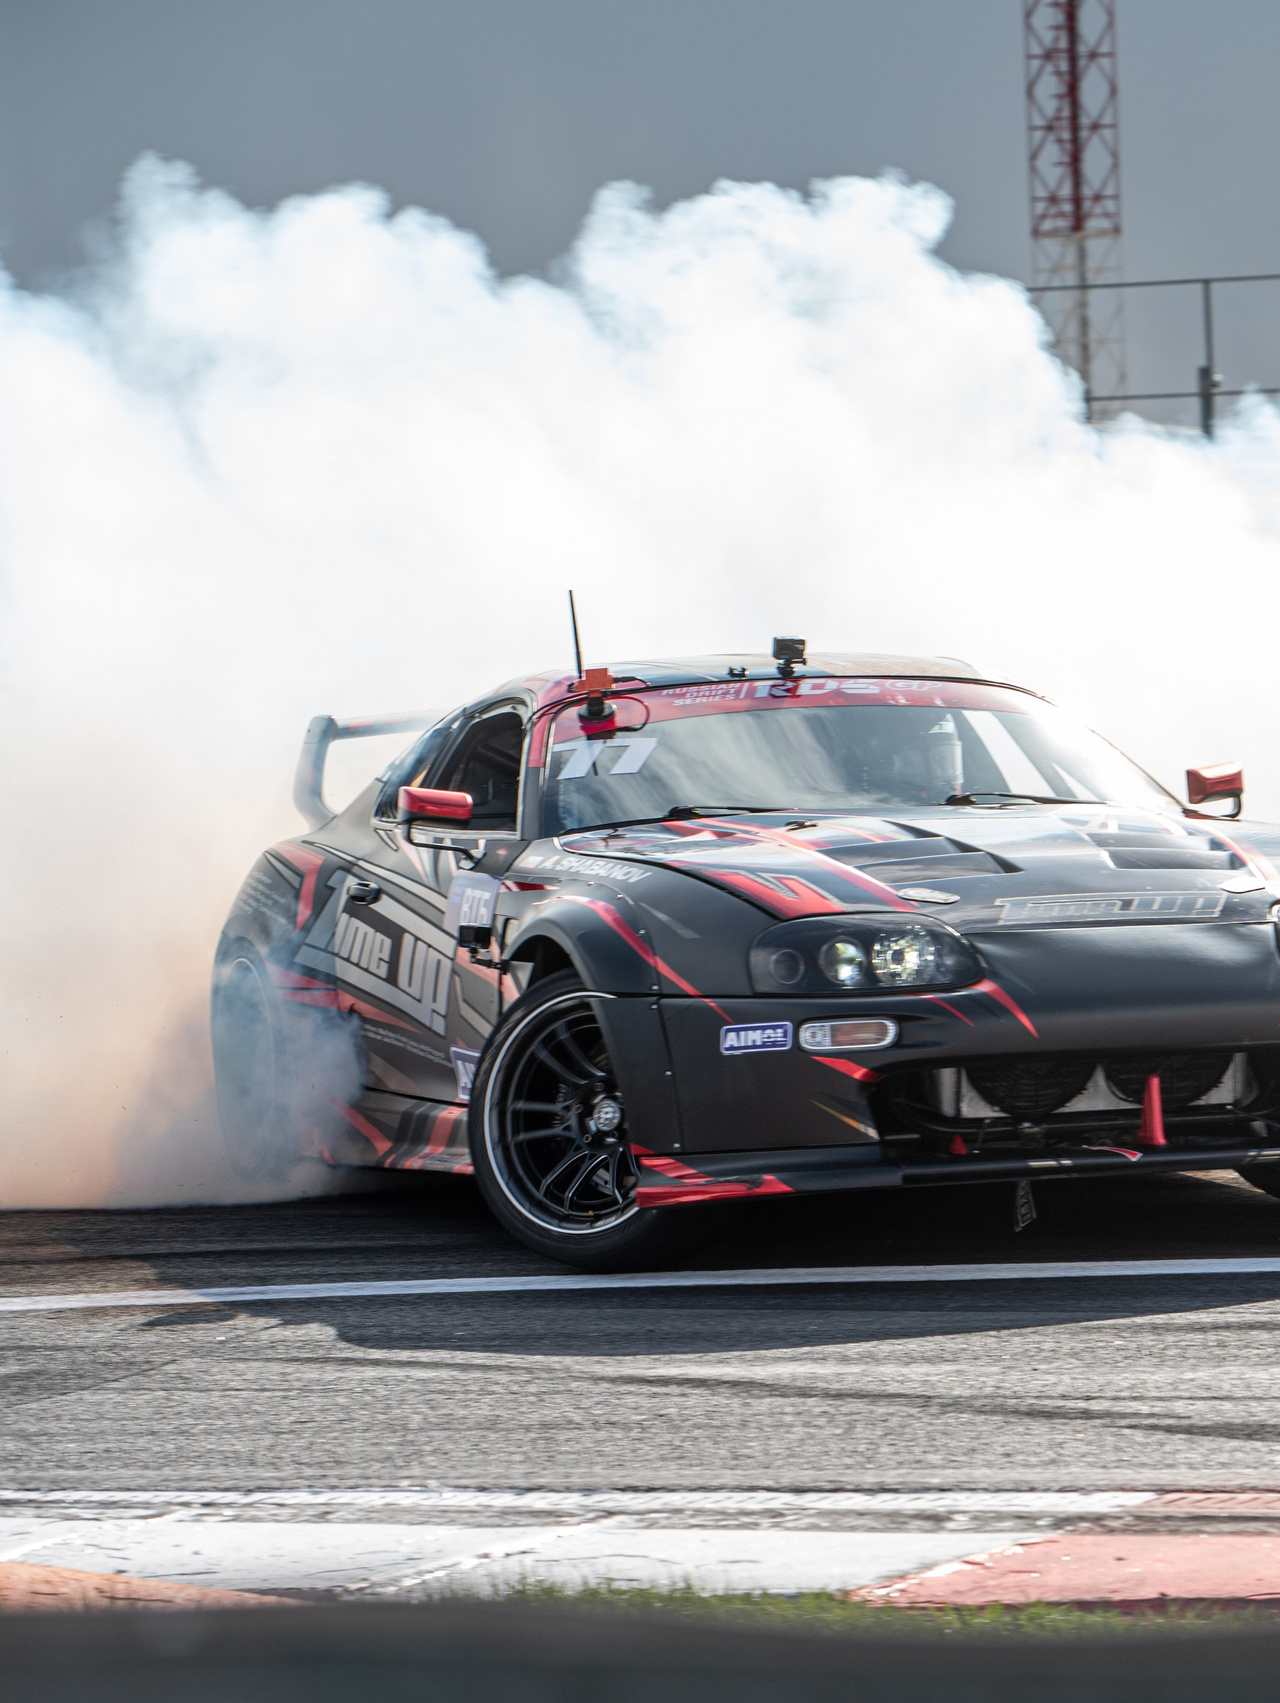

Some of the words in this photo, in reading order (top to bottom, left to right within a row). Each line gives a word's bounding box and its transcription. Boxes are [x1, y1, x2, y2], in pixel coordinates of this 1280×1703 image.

[661, 682, 741, 696] RUSSIAN
[685, 688, 737, 699] DRIFT
[753, 678, 881, 699] RDS
[672, 694, 737, 706] SERIES
[552, 738, 658, 780] 77
[723, 1028, 788, 1048] AIMOL
